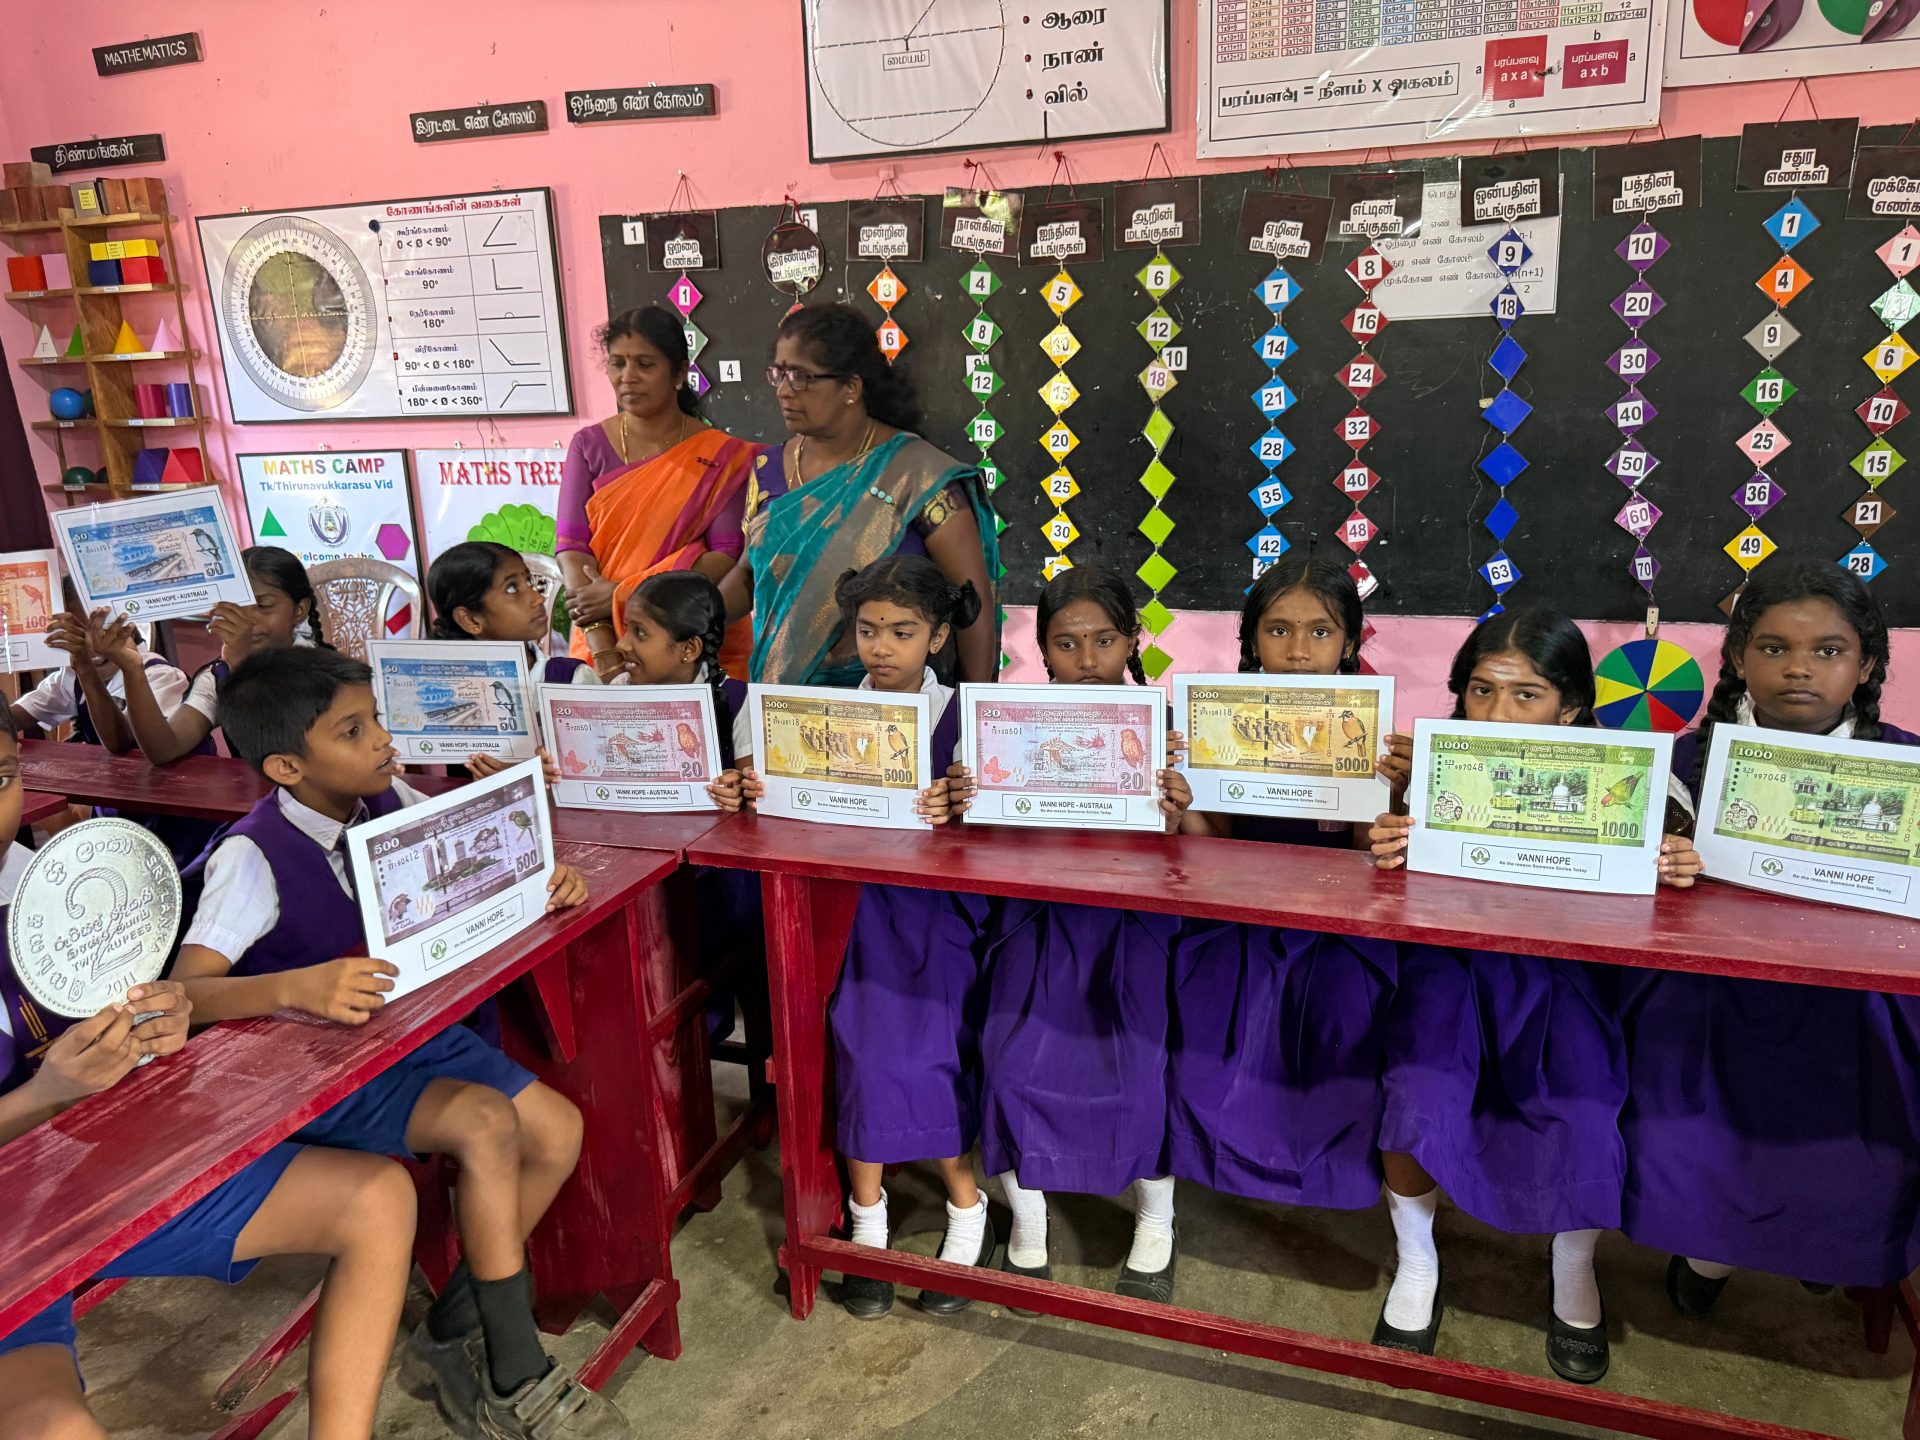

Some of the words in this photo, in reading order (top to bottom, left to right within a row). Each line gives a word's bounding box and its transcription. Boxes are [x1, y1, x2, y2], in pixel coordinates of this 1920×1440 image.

[1041, 7, 1108, 31] ஆரை
[1606, 10, 1643, 21] 12x12=144
[1593, 30, 1601, 41] b
[104, 40, 188, 67] MATHEMATICS
[887, 50, 926, 67] மையம்
[1041, 40, 1105, 72] நாண்
[1493, 54, 1539, 69] பரப்பளவு
[1571, 51, 1618, 65] பரப்பளவு
[1628, 51, 1636, 62] a
[1475, 64, 1482, 75] a
[1501, 72, 1508, 82] a
[1520, 70, 1528, 80] a
[1580, 68, 1588, 78] a
[1601, 63, 1609, 76] b
[1044, 80, 1088, 106] வில்
[1221, 83, 1297, 109] பரப்பளவு
[1303, 85, 1315, 95] =
[1318, 79, 1367, 102] நீளம்
[1388, 69, 1454, 97] அகலம்
[622, 90, 650, 111] எண்
[653, 86, 705, 110] கோலம்
[1508, 99, 1515, 109] a
[415, 117, 460, 137] இரட்டை
[464, 109, 490, 130] எண்
[492, 105, 537, 128] கோலம்
[55, 138, 134, 168] திண்மங்கள்
[1783, 149, 1815, 167] சதுர
[1623, 172, 1673, 194] பத்தின்
[1766, 165, 1827, 184] எண்கள்
[1475, 181, 1538, 204] ஒன்பதின்
[1614, 189, 1682, 213] மடங்குகள்
[386, 198, 467, 217] கோணங்களின்
[471, 193, 522, 210] வகைகள்
[1352, 201, 1393, 217] எட்டின்
[1476, 199, 1538, 220] மடங்குகள்
[1133, 207, 1173, 226] ஆறின்
[1785, 215, 1796, 234] 1
[630, 226, 638, 241] 1
[861, 225, 906, 242] மூன்றின்
[956, 218, 1003, 235] நான்கின்
[1038, 224, 1079, 242] ஐந்தின்
[1126, 225, 1181, 244] மடங்குகள்
[1265, 221, 1300, 239] ஏழின்
[1342, 216, 1401, 237] மடங்குகள்
[667, 239, 699, 254] ஒற்றை
[859, 240, 908, 258] மடங்குகள்
[953, 234, 1003, 252] மடங்குகள்
[1032, 240, 1085, 258] மடங்குகள்
[1251, 237, 1309, 257] மடங்குகள்
[1631, 236, 1653, 255] 10
[665, 252, 702, 267] எண்கள்
[1504, 246, 1515, 263] 9
[1901, 243, 1912, 261] 1
[1364, 260, 1375, 276] 8
[975, 276, 985, 291] 4
[1154, 271, 1164, 287] 6
[1439, 273, 1459, 281] எண்
[1778, 271, 1789, 289] 4
[681, 288, 688, 303] 1
[883, 281, 892, 298] 3
[1055, 286, 1066, 302] 5
[1272, 284, 1283, 300] 7
[1500, 298, 1515, 316] 18
[1626, 296, 1649, 313] 20
[1151, 321, 1168, 338] 12
[1357, 313, 1376, 330] 16
[885, 332, 895, 346] 6
[978, 324, 986, 340] 8
[1767, 326, 1777, 343] 9
[1266, 340, 1285, 355] 14
[1166, 350, 1183, 367] 10
[1622, 352, 1645, 370] 30
[1883, 348, 1894, 366] 6
[726, 363, 734, 379] 4
[1149, 371, 1166, 387] 18
[1351, 367, 1373, 383] 24
[974, 375, 991, 391] 12
[1758, 382, 1779, 399] 16
[1264, 391, 1283, 406] 21
[1619, 405, 1642, 422] 40
[1872, 404, 1893, 422] 10
[976, 424, 993, 438] 16
[1348, 420, 1368, 436] 32
[1051, 434, 1069, 449] 20
[1262, 442, 1282, 457] 28
[1752, 433, 1774, 450] 25
[263, 459, 326, 476] MATHS
[332, 457, 385, 475] CAMP
[1621, 455, 1643, 472] 50
[1867, 454, 1888, 473] 15
[438, 461, 511, 486] MATHS
[1346, 472, 1367, 488] 40
[375, 479, 393, 490] Vid
[1053, 479, 1071, 494] 25
[1261, 488, 1282, 505] 35
[1746, 485, 1767, 503] 36
[1629, 506, 1649, 524] 60
[1859, 504, 1879, 521] 21
[1053, 524, 1070, 539] 30
[1348, 523, 1367, 539] 48
[1260, 539, 1280, 554] 42
[1740, 538, 1761, 554] 49
[1490, 565, 1510, 581] 63
[1637, 561, 1651, 577] 70
[1850, 556, 1871, 573] 28
[1191, 691, 1219, 699] 5000
[765, 701, 788, 709] 5000
[984, 708, 1001, 718] 20
[1437, 740, 1469, 751] 1000
[1738, 747, 1773, 760] 1000
[681, 761, 703, 778] 20
[1335, 757, 1369, 773] 5000
[1119, 772, 1144, 790] 20
[1266, 786, 1290, 796] VANNI
[1291, 789, 1313, 797] HOPE
[1600, 821, 1639, 839] 1000
[373, 837, 400, 855] 500
[516, 850, 538, 873] 500
[1517, 853, 1544, 863] VANNI
[1546, 856, 1571, 866] HOPE
[1814, 868, 1845, 880] VANNI
[1846, 872, 1875, 885] HOPE
